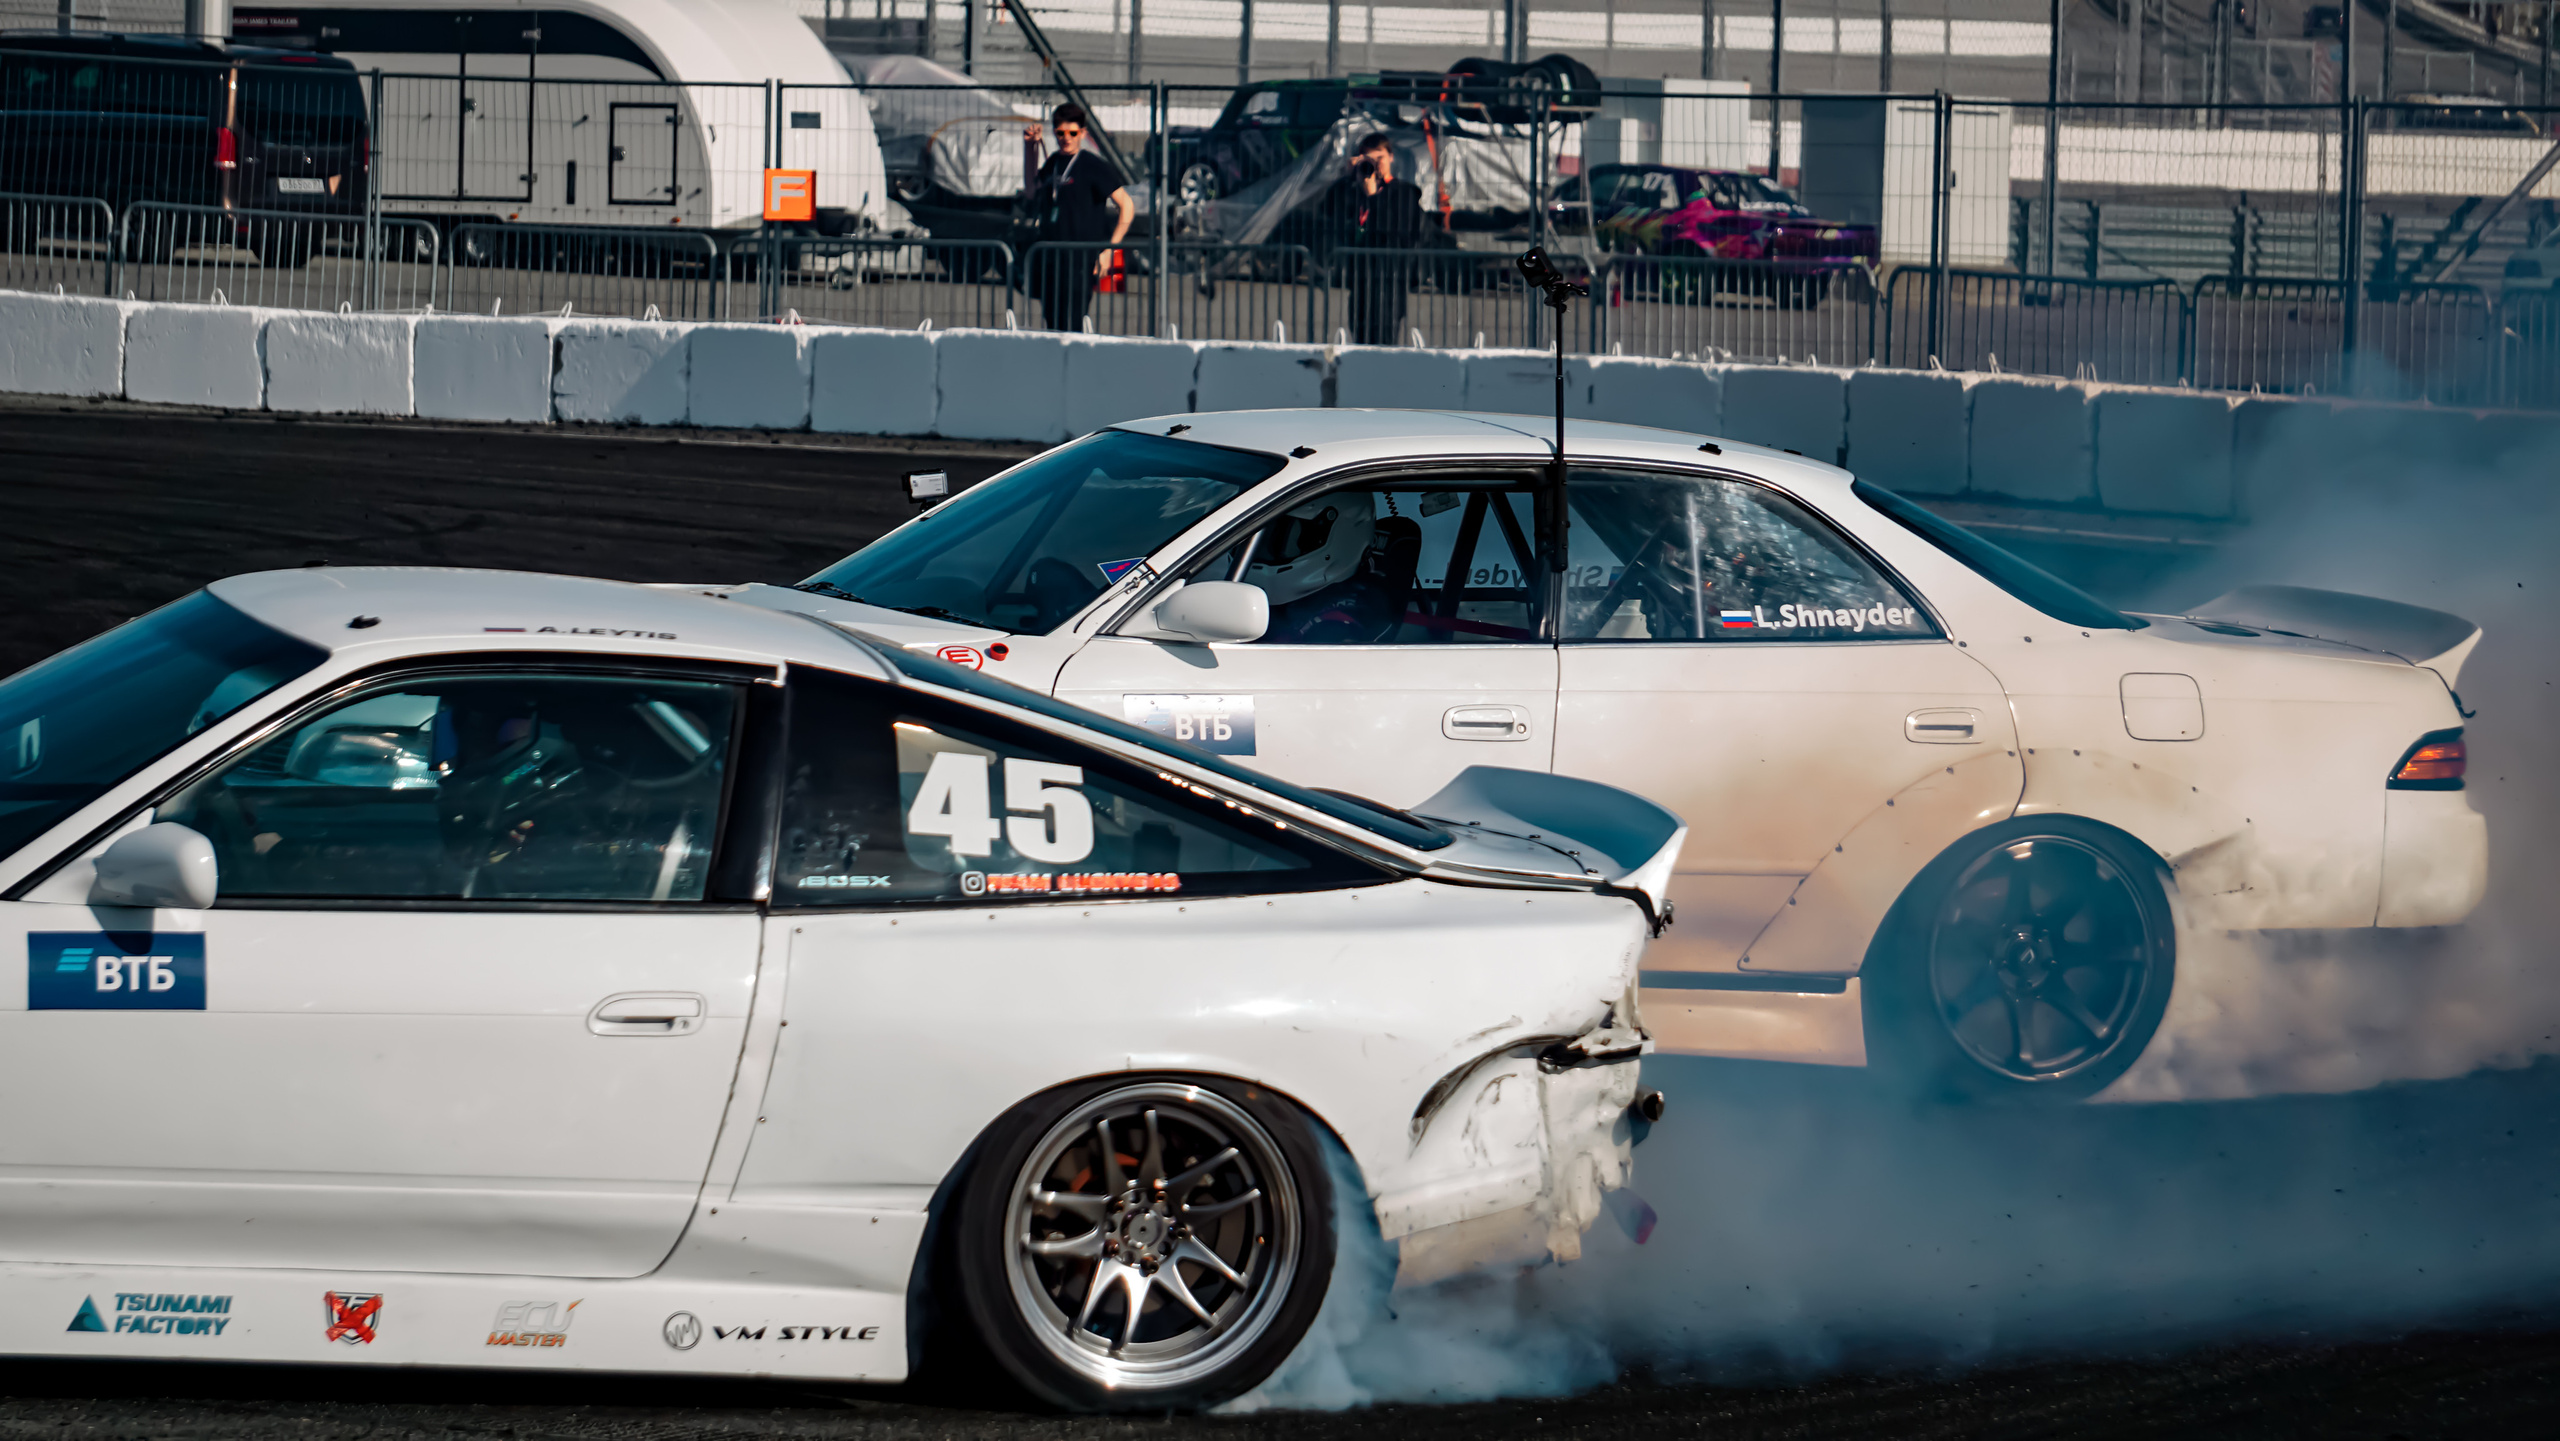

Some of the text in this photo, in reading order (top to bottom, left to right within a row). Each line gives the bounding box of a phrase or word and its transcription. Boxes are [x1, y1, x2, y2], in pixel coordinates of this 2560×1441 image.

[771, 176, 806, 211] F
[1754, 602, 1915, 632] L.Shnayder
[537, 626, 678, 640] A.LEYTIS
[1175, 713, 1232, 741] ВТБ
[908, 751, 1094, 864] 45
[96, 956, 176, 992] ВТБ
[115, 1293, 233, 1314] TSUNAMI
[494, 1299, 582, 1333] ECU
[114, 1315, 231, 1336] FACTORY
[486, 1332, 567, 1347] MASTER
[712, 1325, 881, 1340] VM STYLE
